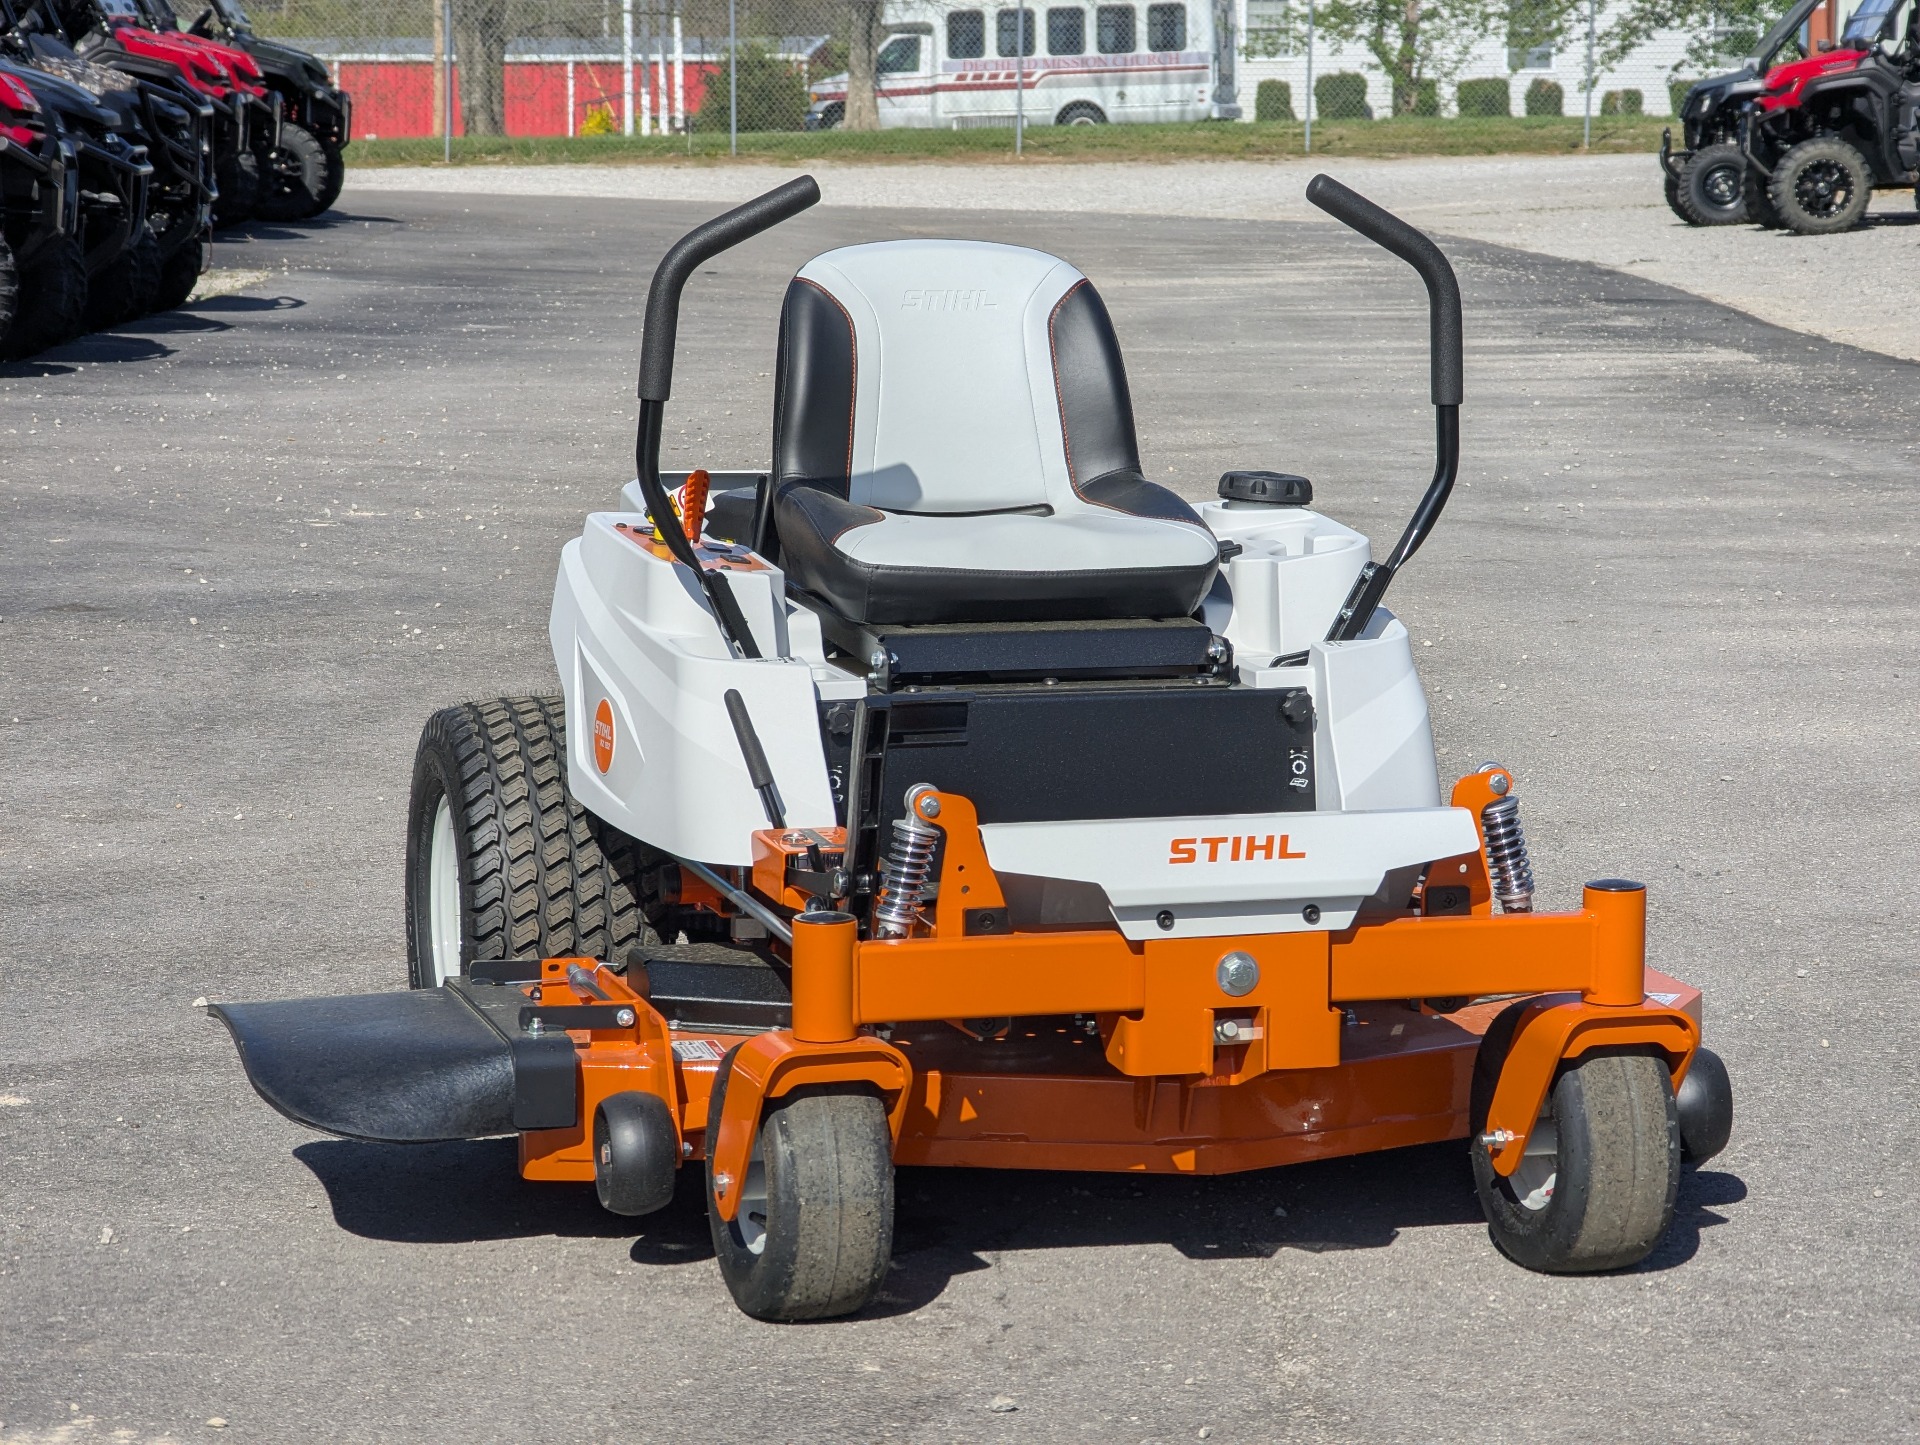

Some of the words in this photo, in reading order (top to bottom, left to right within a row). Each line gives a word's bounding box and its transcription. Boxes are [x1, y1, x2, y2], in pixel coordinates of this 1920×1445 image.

[1043, 56, 1107, 69] MISSION
[1112, 53, 1179, 66] CHURCH
[901, 289, 998, 311] STIHL
[594, 719, 611, 740] STIHL
[1169, 834, 1306, 864] STIHL
